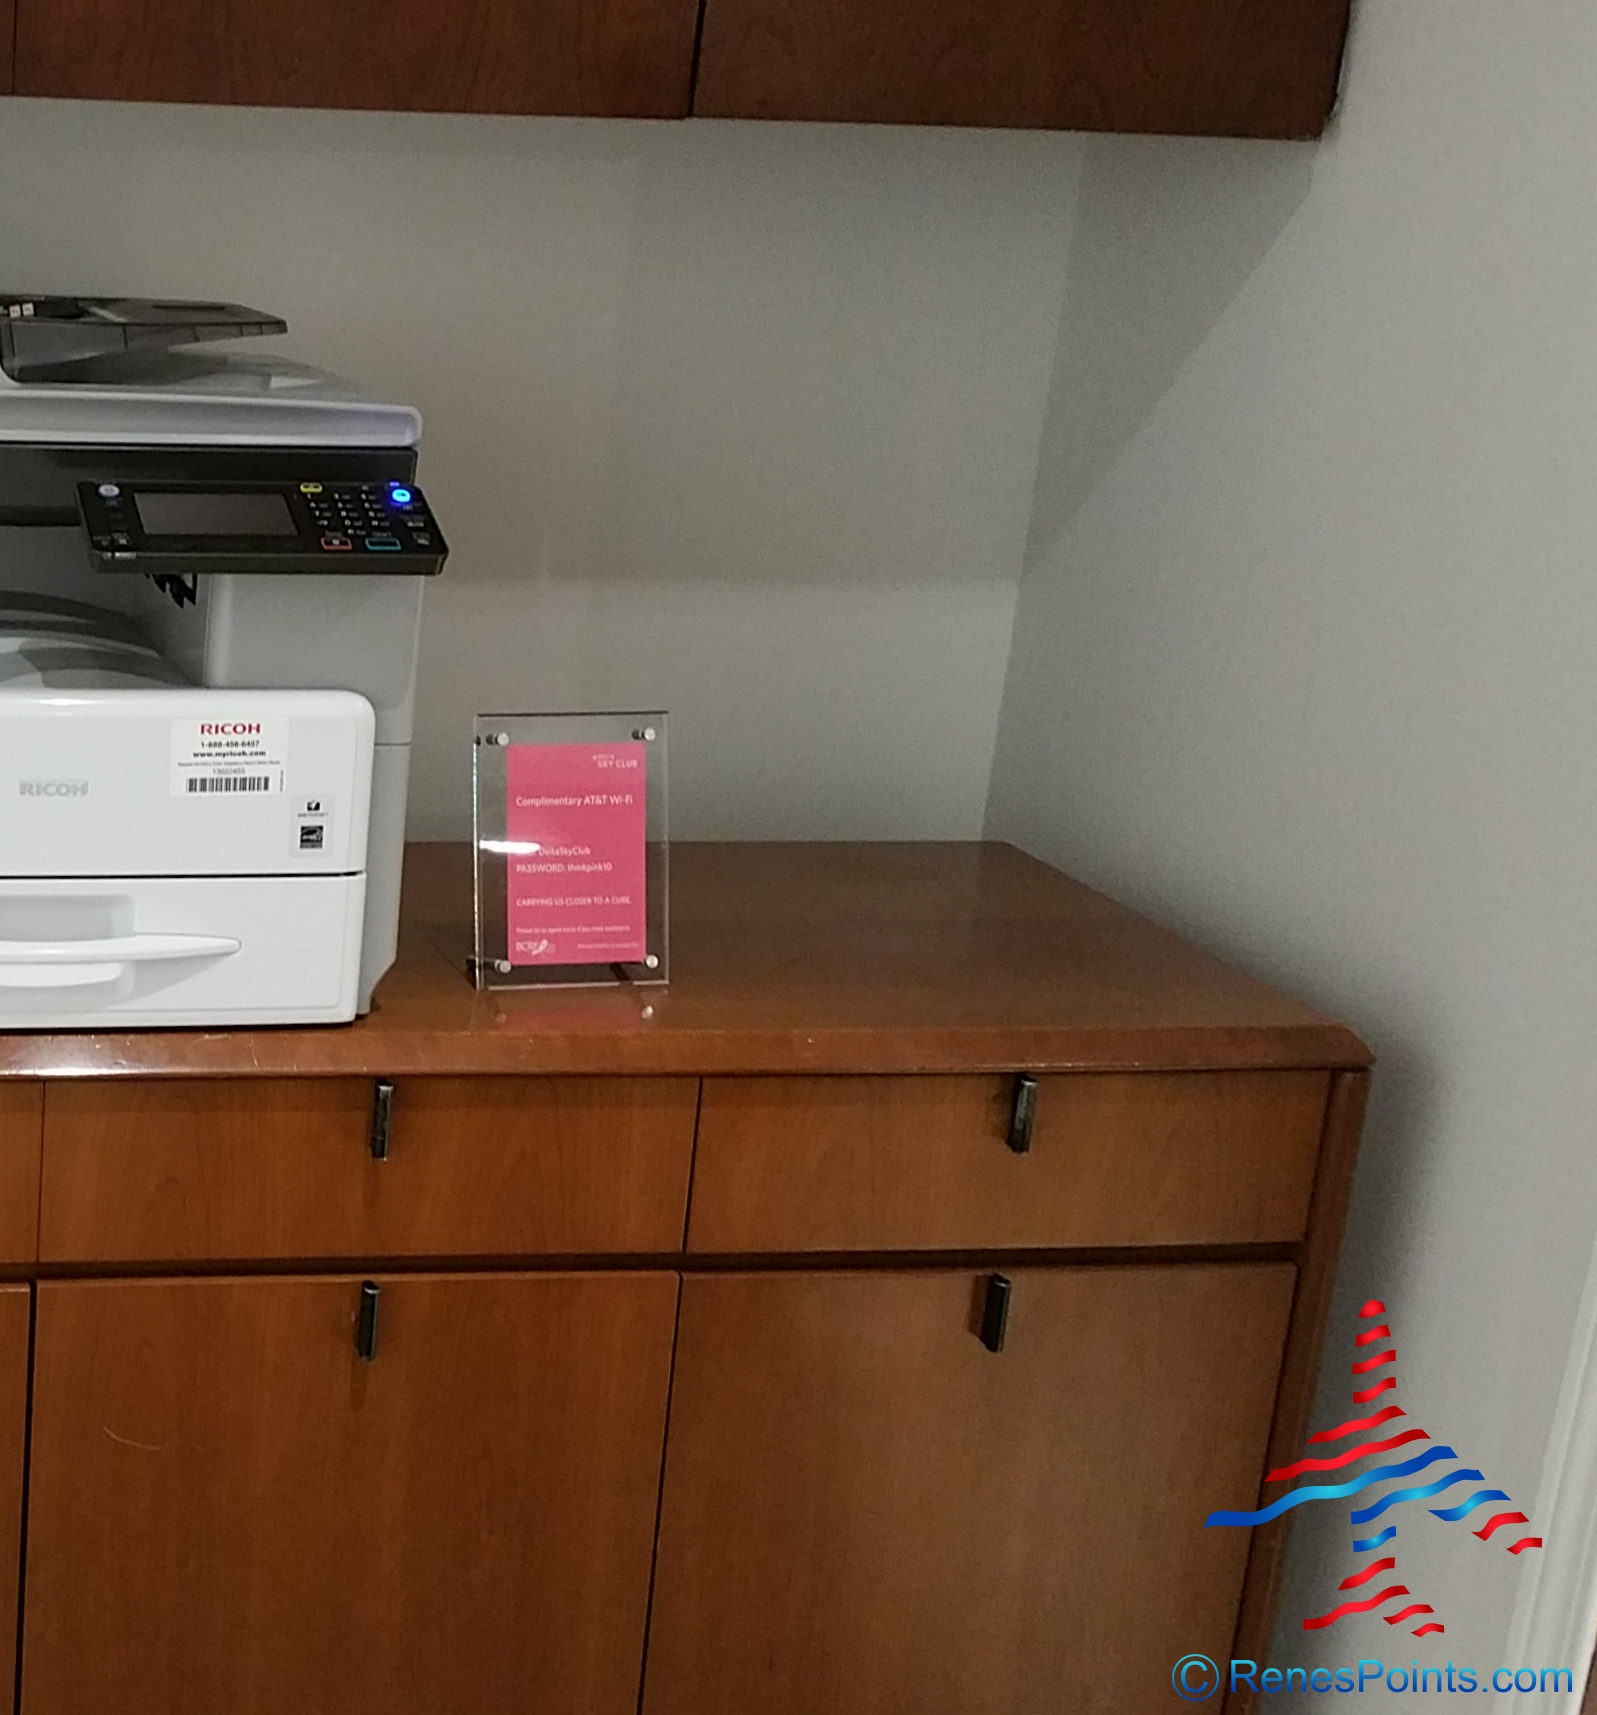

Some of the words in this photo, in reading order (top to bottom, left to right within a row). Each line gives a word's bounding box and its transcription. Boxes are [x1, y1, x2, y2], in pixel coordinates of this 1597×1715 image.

[200, 723, 261, 735] RICOH
[598, 760, 614, 769] SKY
[616, 759, 638, 769] CLUB
[19, 780, 90, 797] RICOH
[516, 796, 582, 808] Complimentary
[584, 795, 608, 805] AT&T
